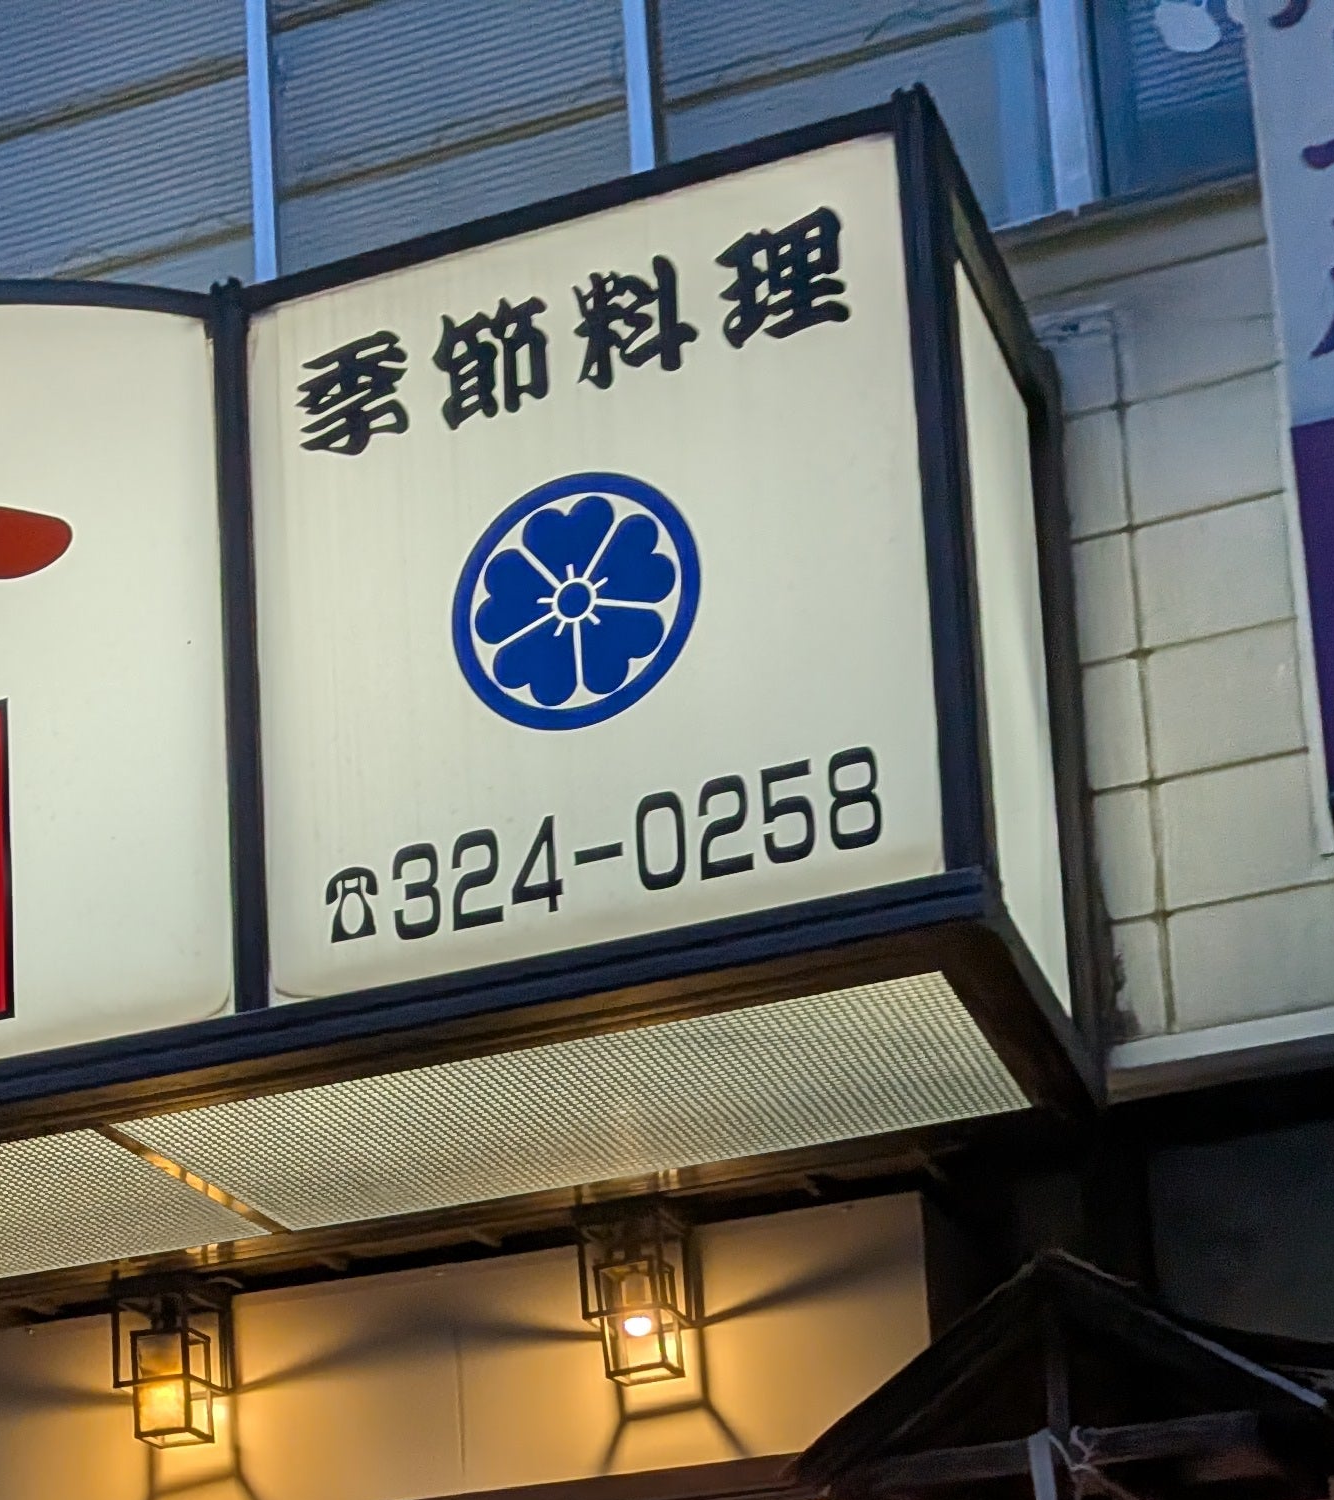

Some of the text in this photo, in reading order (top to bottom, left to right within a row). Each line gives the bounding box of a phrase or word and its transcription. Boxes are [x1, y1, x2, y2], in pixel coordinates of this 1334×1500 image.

[295, 206, 852, 456] 季節料理
[391, 746, 882, 941] 324-0258
